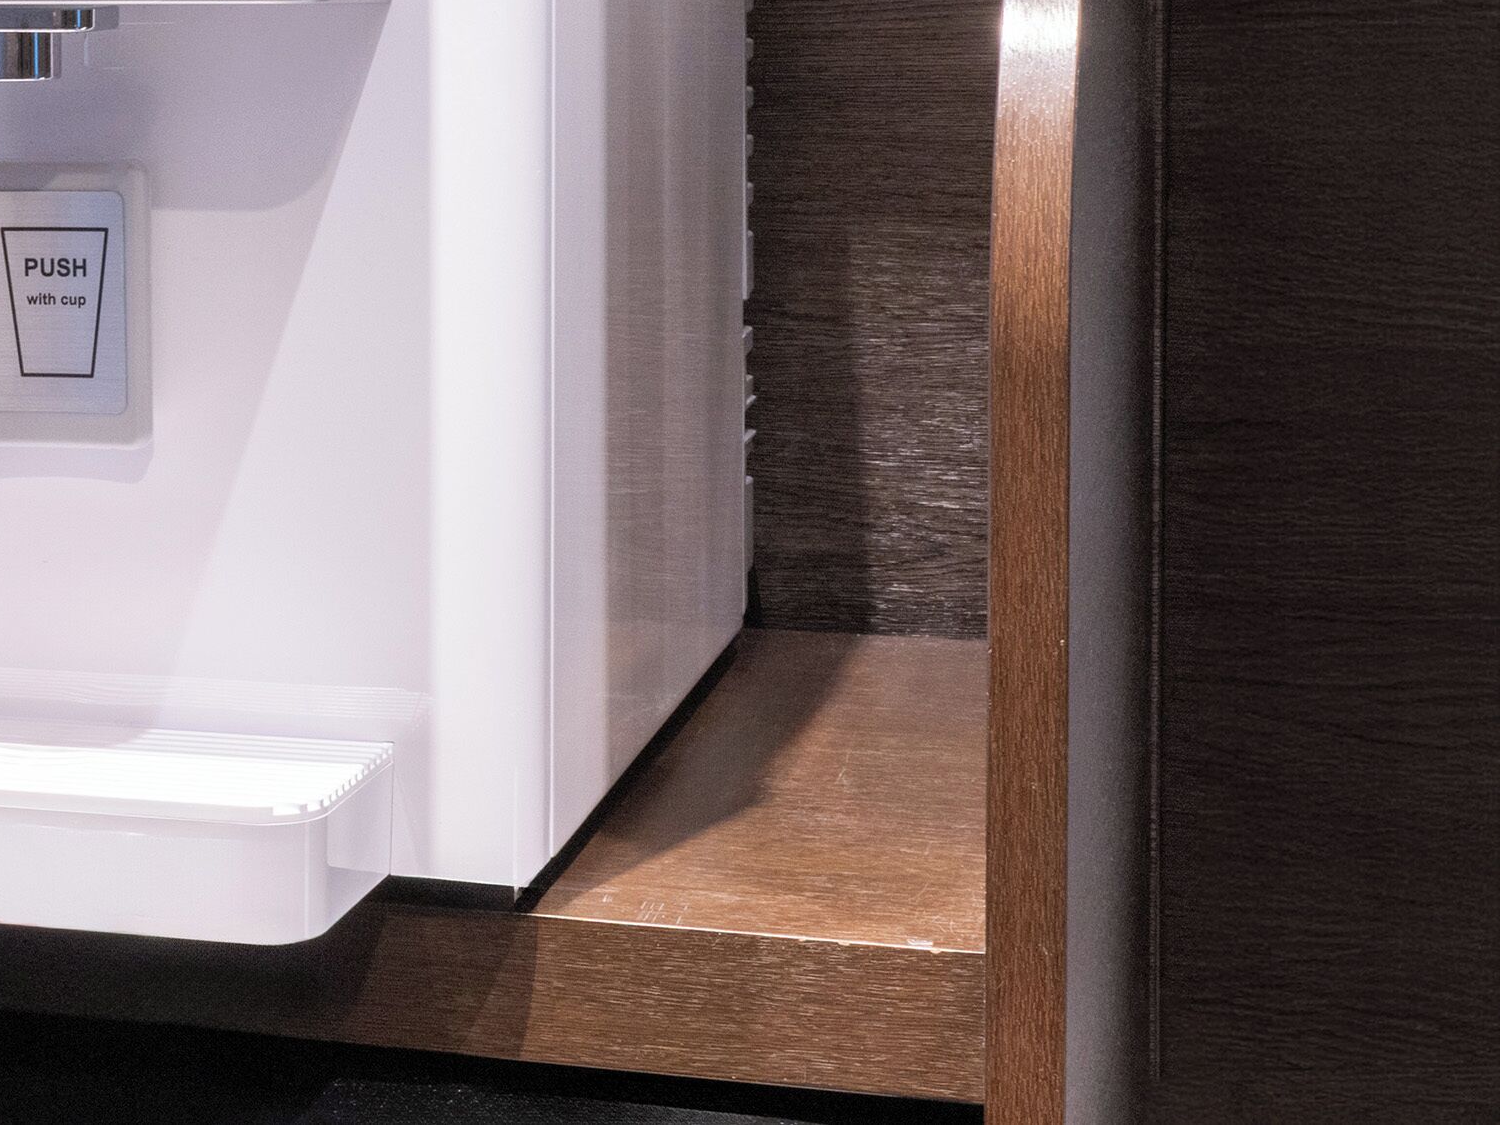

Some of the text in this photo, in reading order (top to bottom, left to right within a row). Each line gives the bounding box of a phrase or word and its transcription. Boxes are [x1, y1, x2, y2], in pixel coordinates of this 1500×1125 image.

[24, 257, 88, 277] PUSH
[26, 292, 87, 309] with cup
